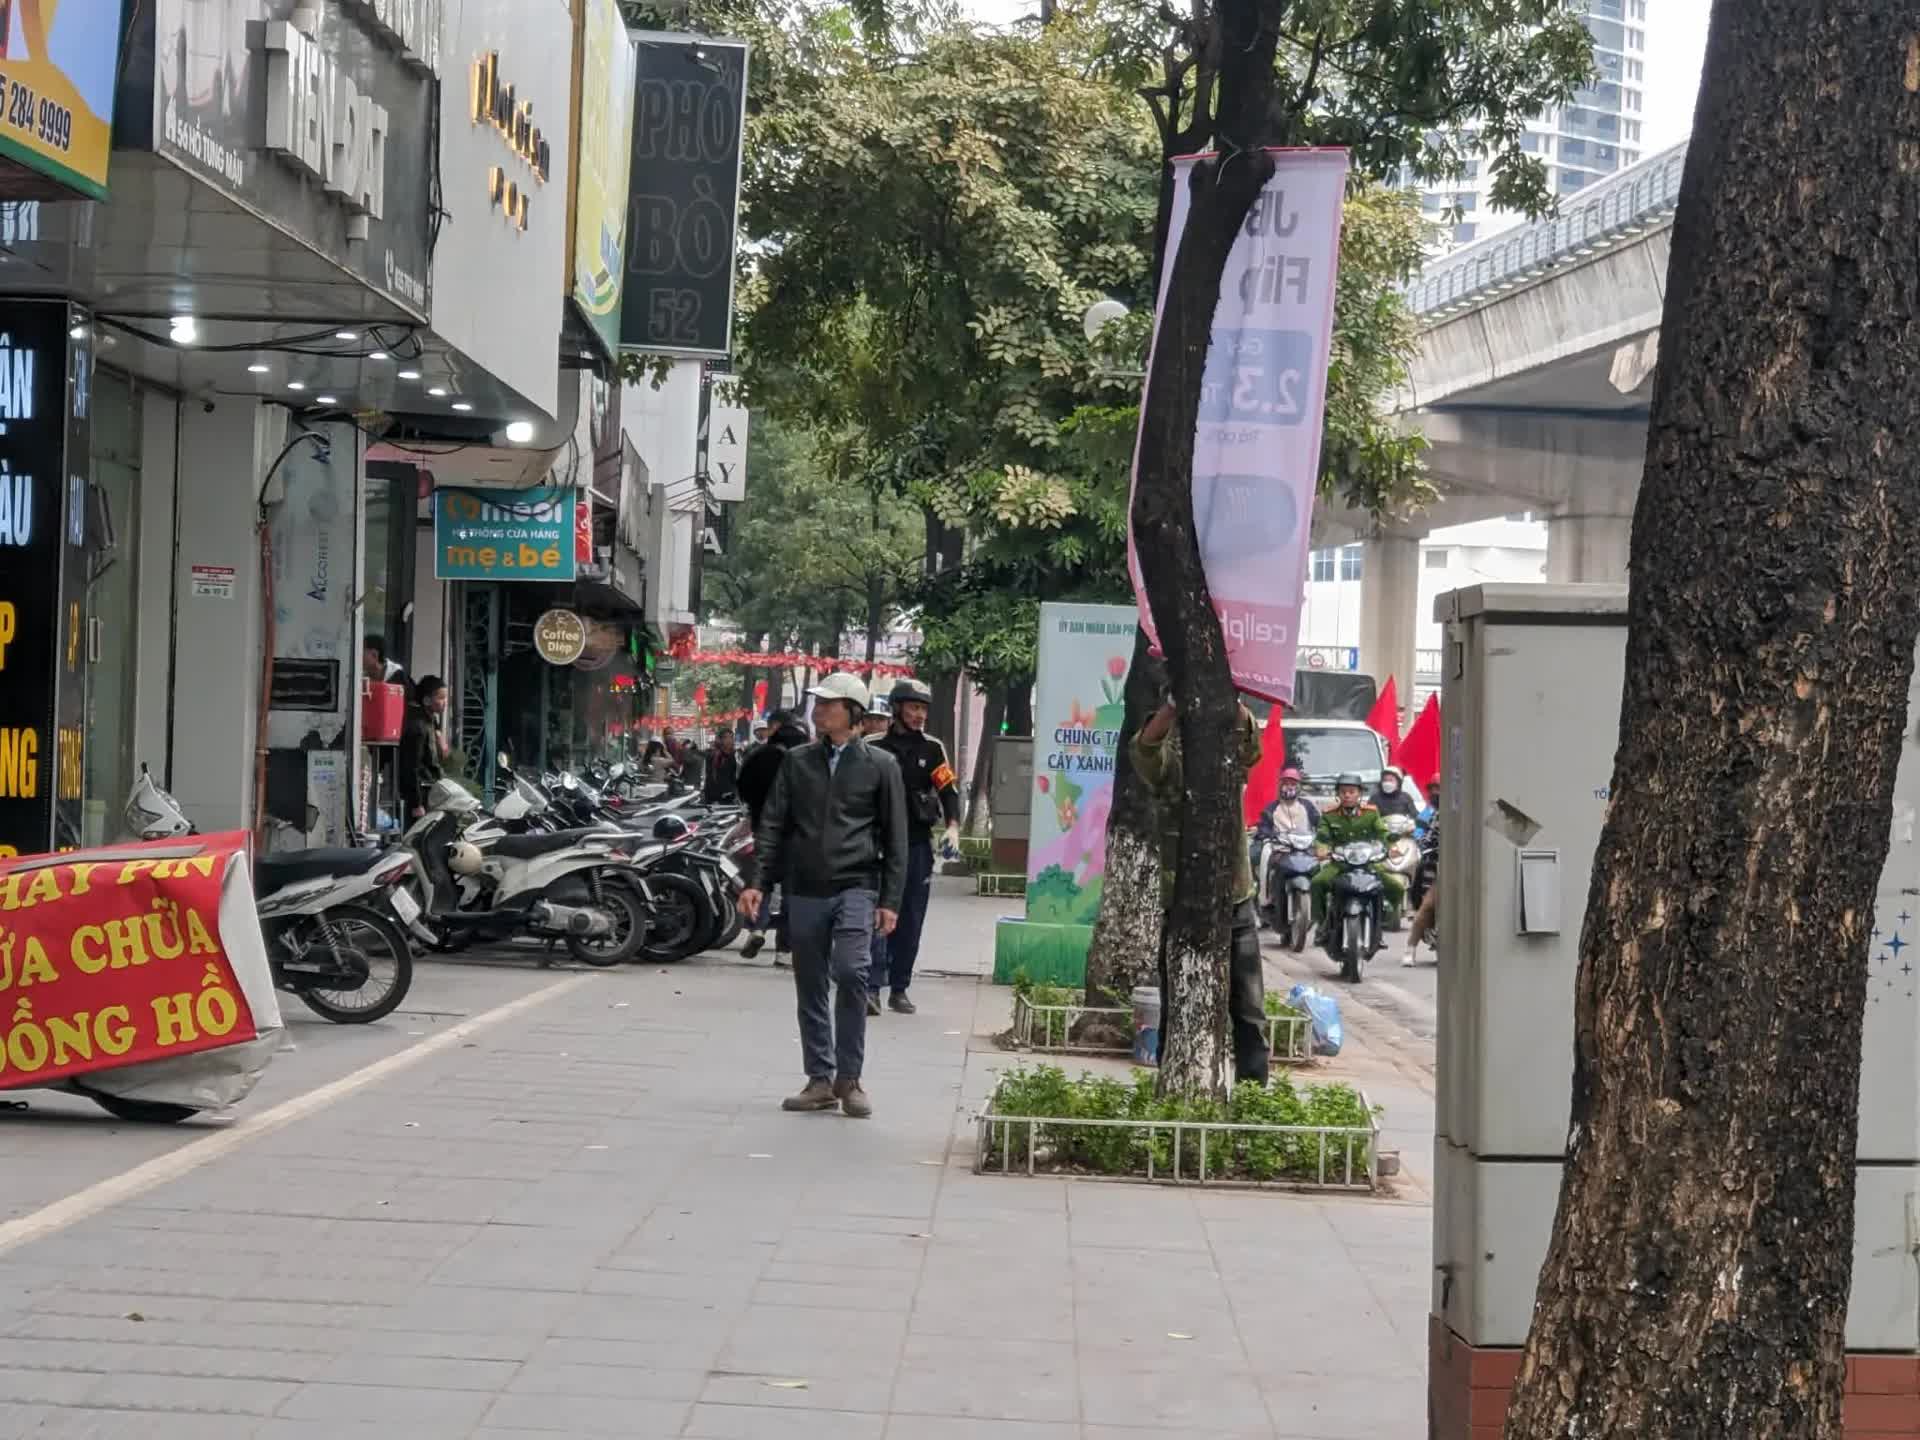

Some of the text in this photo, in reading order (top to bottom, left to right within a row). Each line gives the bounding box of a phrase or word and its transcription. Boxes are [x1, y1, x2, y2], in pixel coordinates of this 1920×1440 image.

[8, 80, 36, 134] 284
[38, 96, 72, 153] 9999
[648, 288, 700, 343] 52
[447, 542, 561, 573] mẹ & bé
[542, 629, 580, 641] Coffee
[1054, 728, 1101, 745] CHUNG
[1047, 751, 1113, 771] CÂY XANH
[71, 898, 219, 974] CHỮA
[0, 962, 238, 1072] ỒNG HỒ
